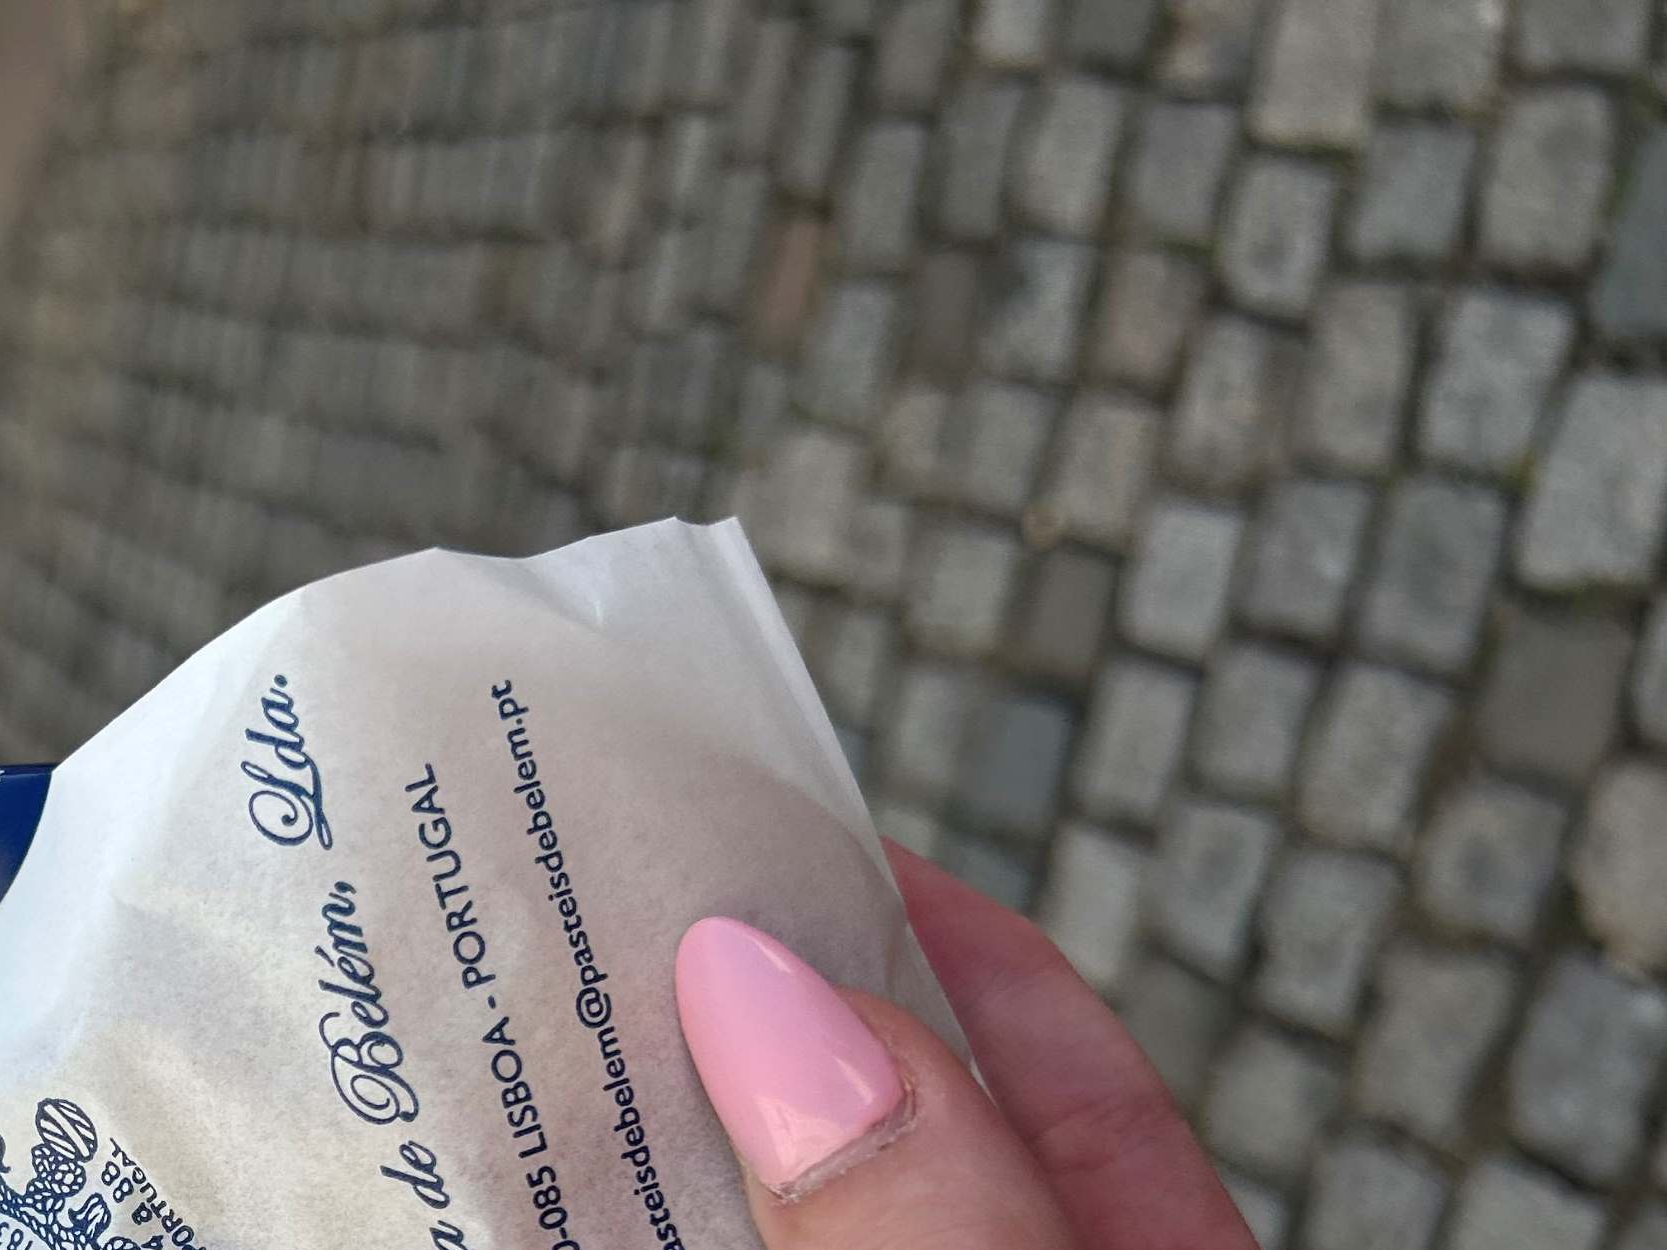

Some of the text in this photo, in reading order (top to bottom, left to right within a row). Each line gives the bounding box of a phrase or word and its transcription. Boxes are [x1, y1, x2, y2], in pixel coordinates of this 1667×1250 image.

[240, 673, 334, 851] Lda.
[404, 762, 495, 990] PORTUGAL
[315, 880, 420, 1126] Belém,
[482, 1016, 548, 1159] LISBOA
[100, 1163, 139, 1202] 88
[380, 1140, 451, 1209] de
